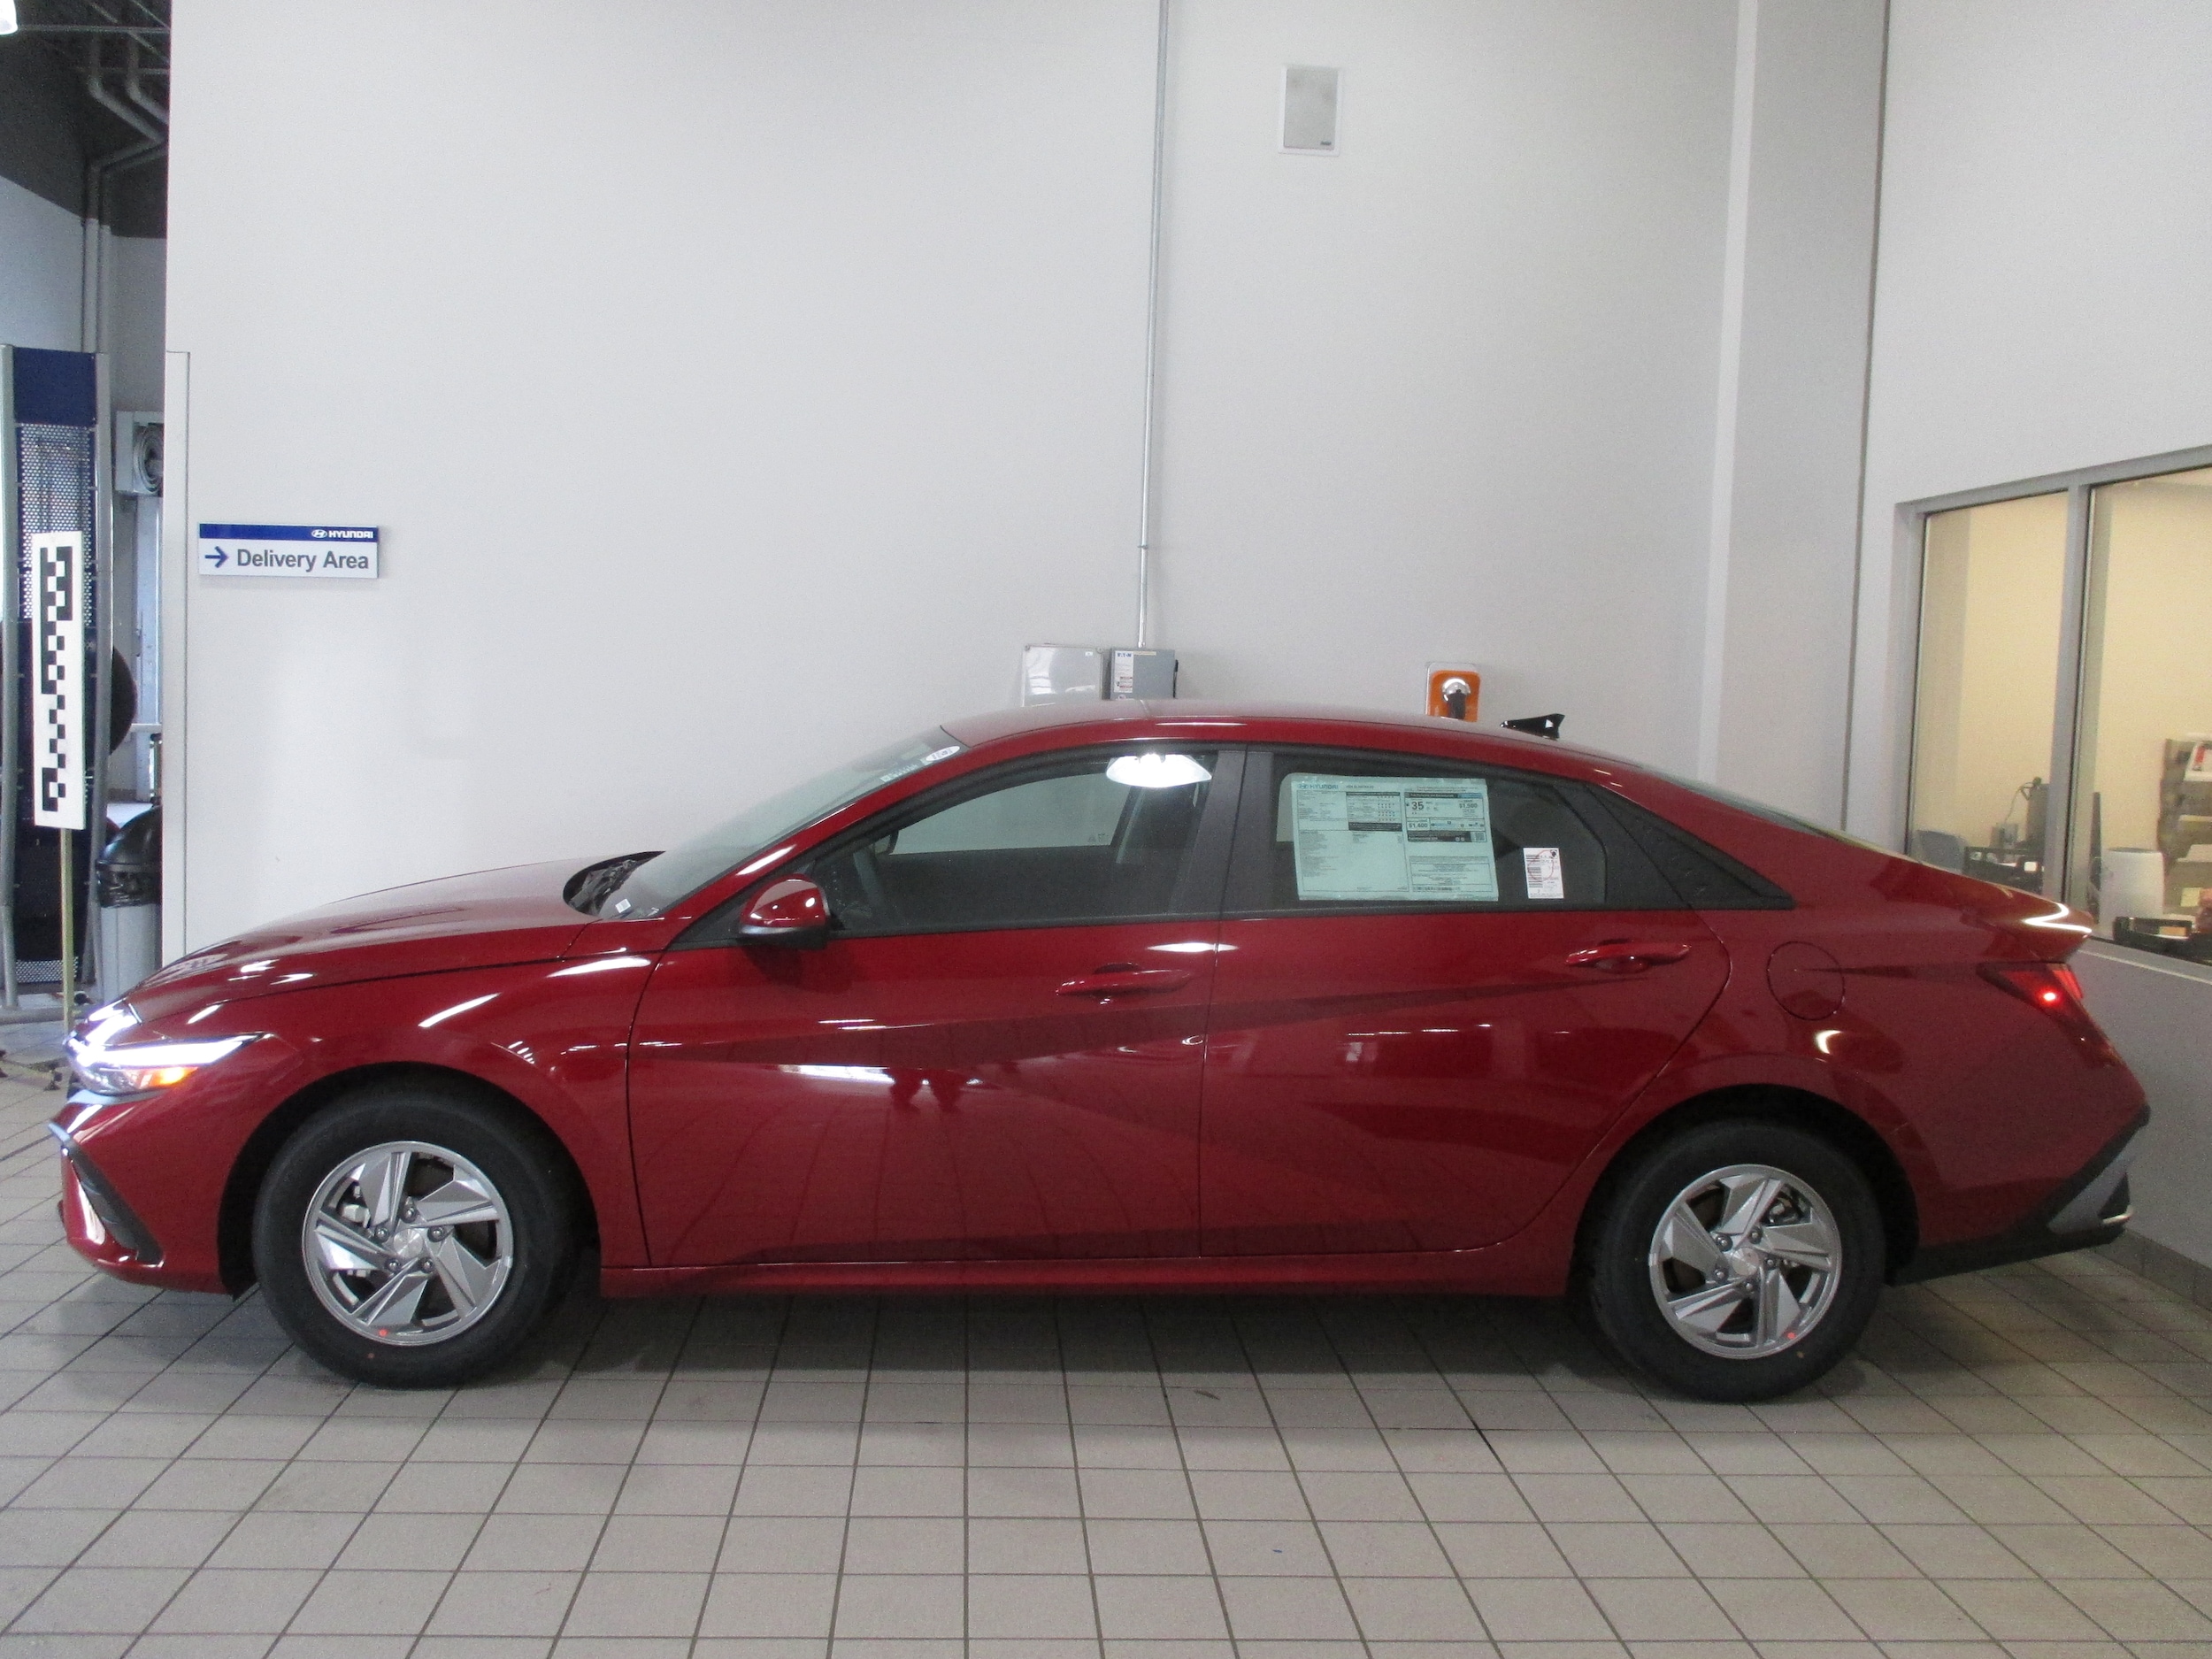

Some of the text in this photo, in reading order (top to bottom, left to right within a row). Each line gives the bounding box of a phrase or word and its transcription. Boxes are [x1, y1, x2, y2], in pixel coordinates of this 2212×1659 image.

[328, 529, 373, 539] HYUNDAI
[237, 549, 369, 572] Delivery Area
[1411, 801, 1425, 810] 35
